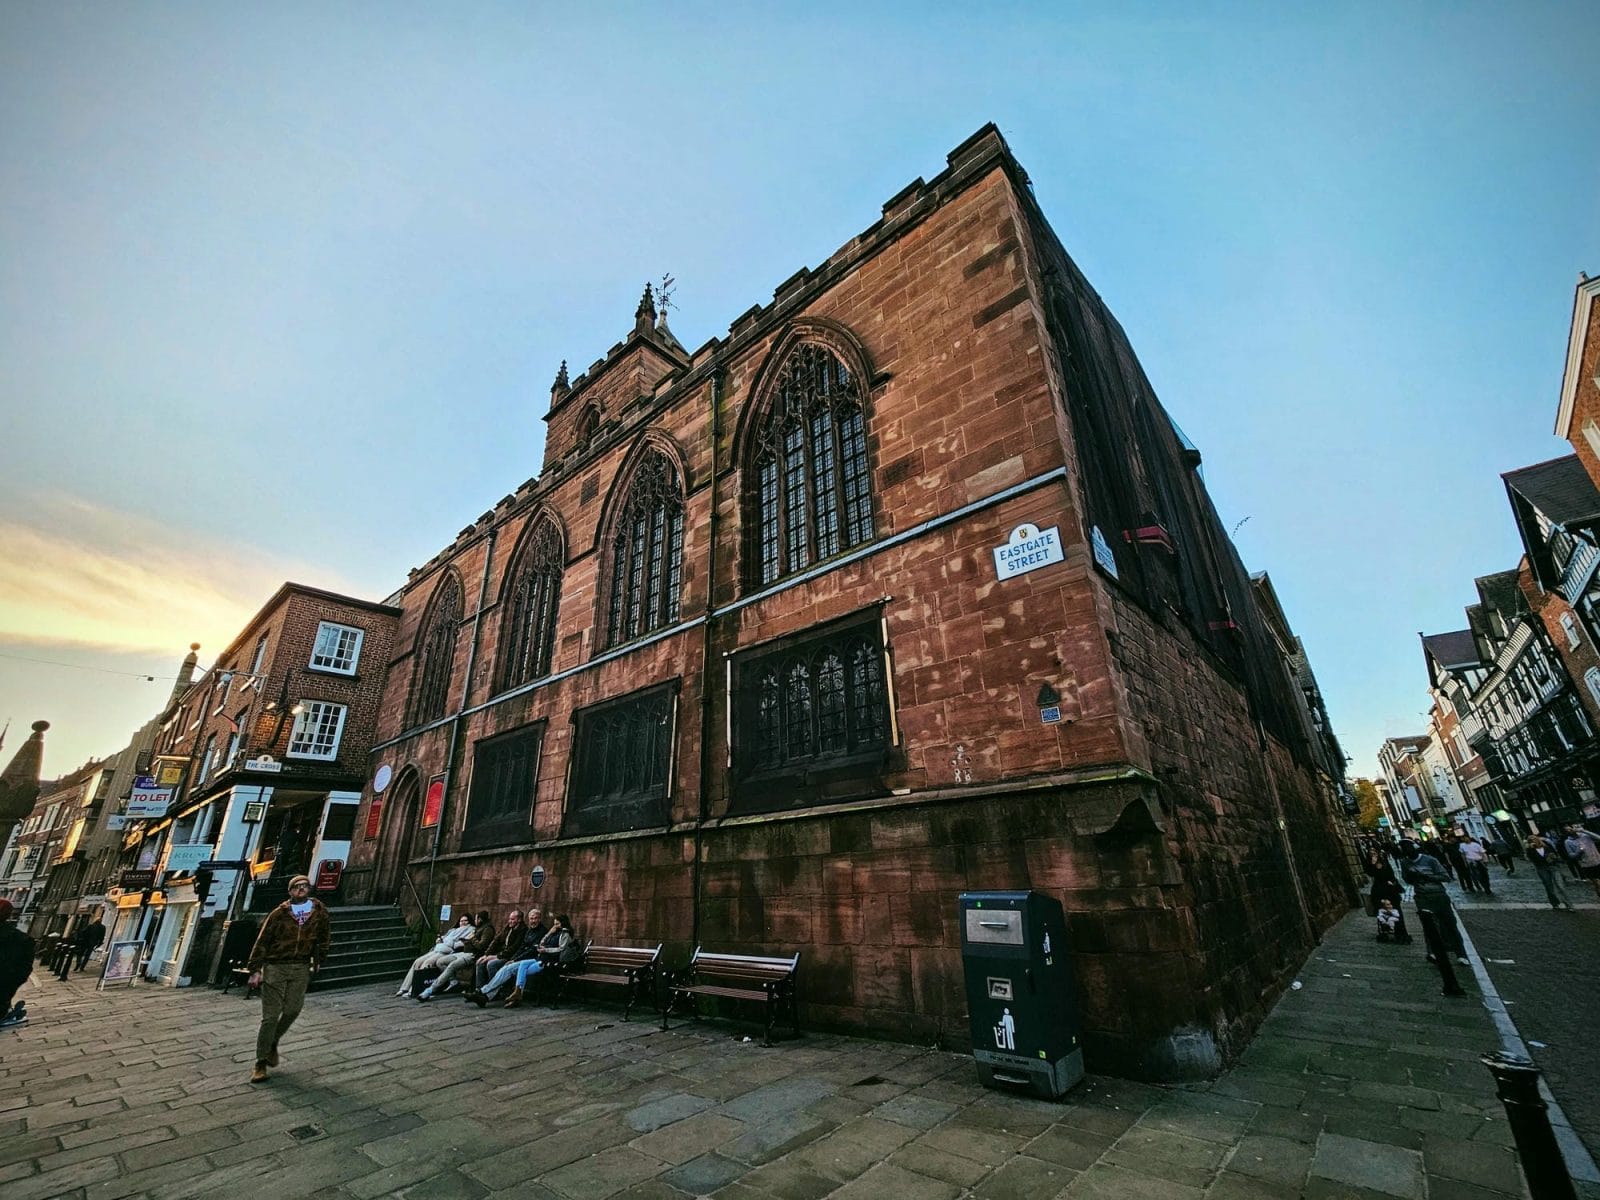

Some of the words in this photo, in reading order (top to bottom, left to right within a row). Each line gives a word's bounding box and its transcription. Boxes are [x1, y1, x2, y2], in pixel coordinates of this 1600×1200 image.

[1000, 533, 1054, 560] EASTGATE
[1007, 548, 1049, 571] STREET
[133, 794, 147, 802] TO
[150, 793, 169, 802] LET
